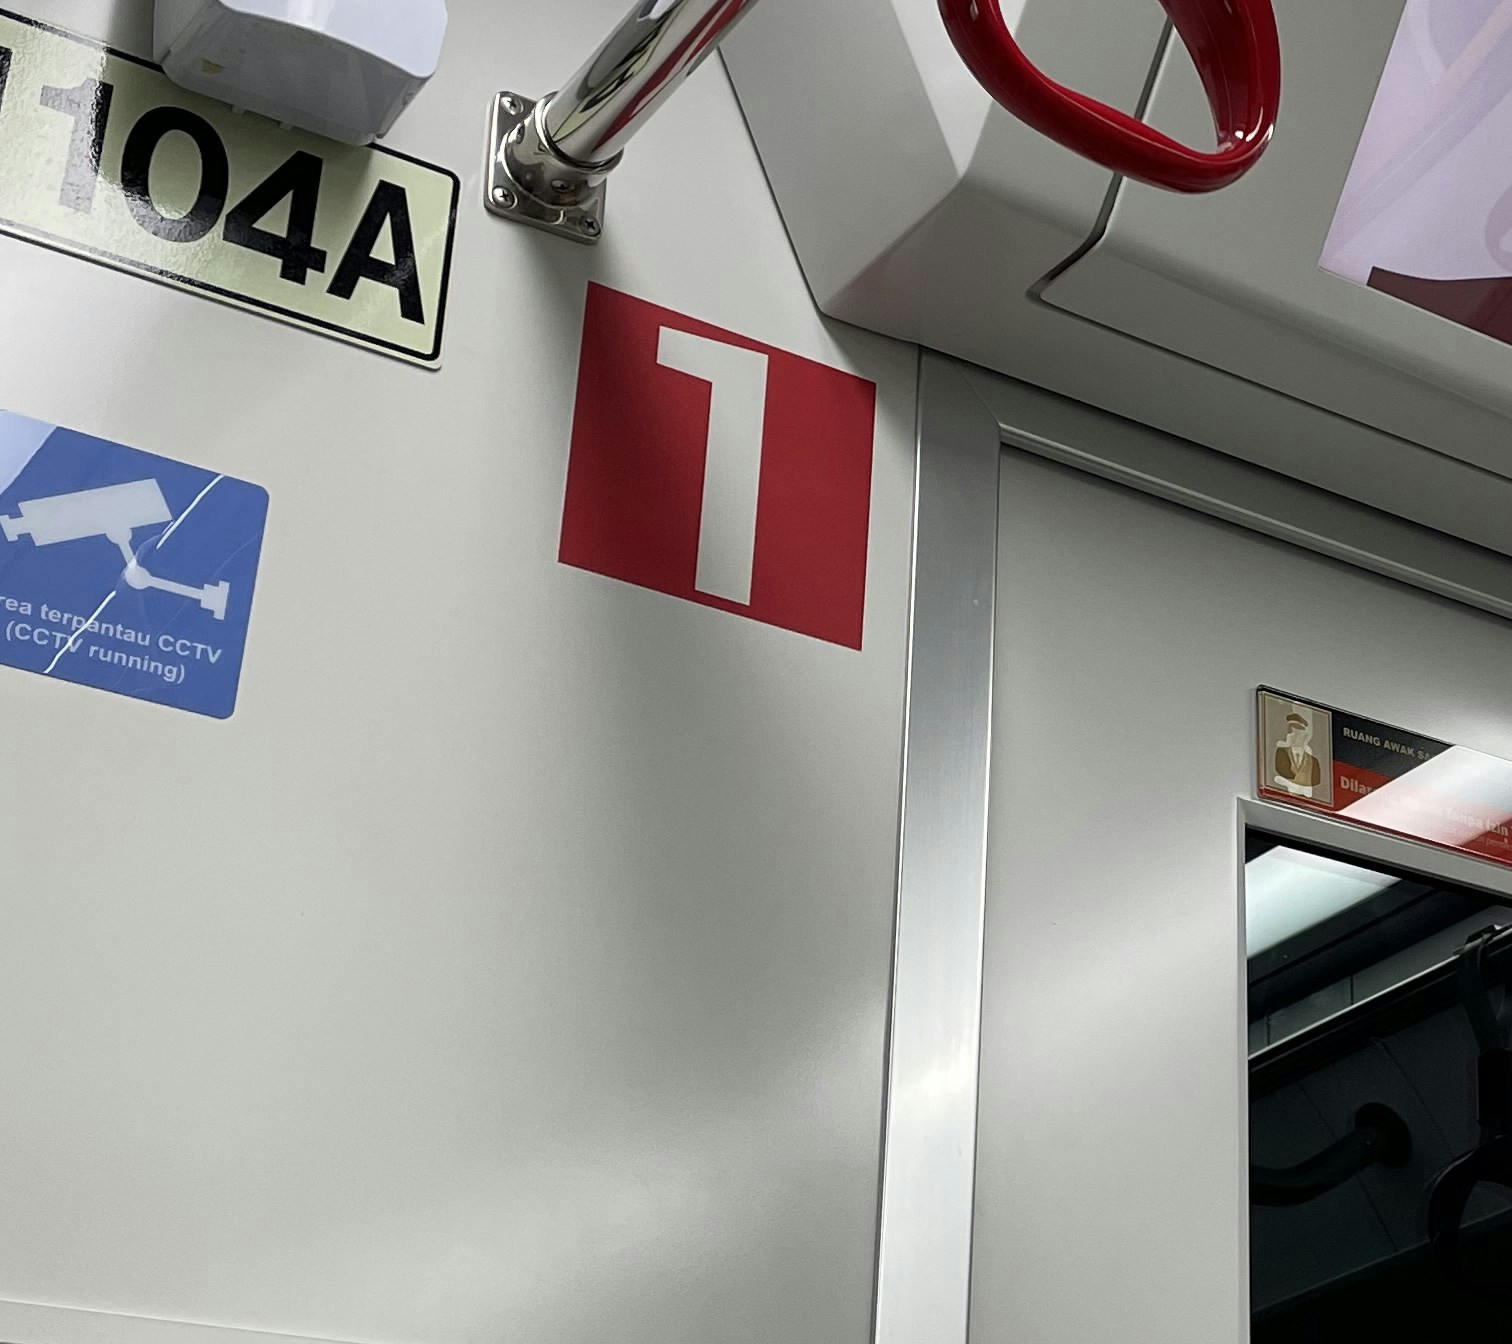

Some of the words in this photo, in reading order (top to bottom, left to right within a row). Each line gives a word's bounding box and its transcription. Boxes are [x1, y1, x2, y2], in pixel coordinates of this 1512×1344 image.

[0, 44, 425, 325] 104A
[656, 325, 768, 606] 1
[6, 620, 83, 653] (CCTV
[88, 645, 185, 684] running)
[41, 603, 150, 646] terpantau
[158, 634, 222, 664] CCTV
[1343, 727, 1381, 747] RUANG
[1383, 739, 1415, 757] AWAK
